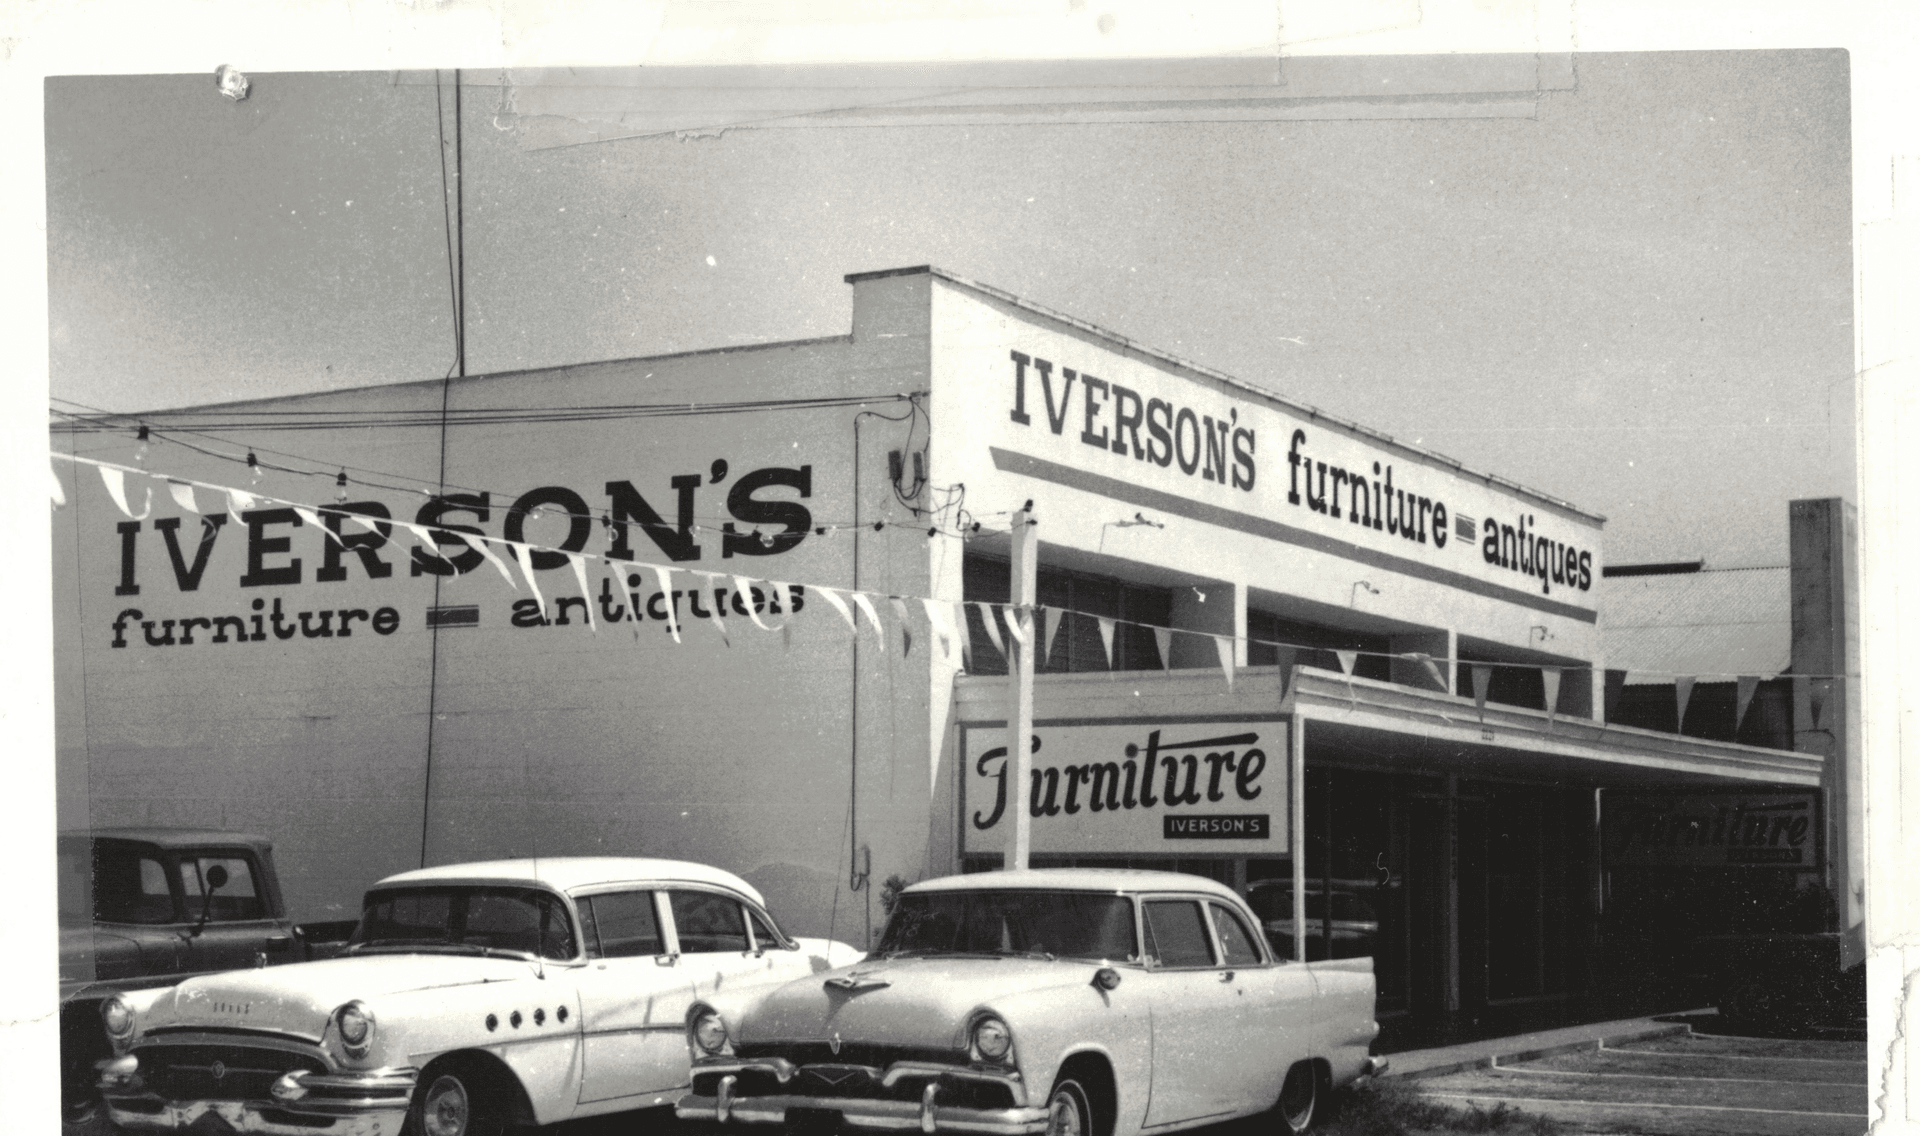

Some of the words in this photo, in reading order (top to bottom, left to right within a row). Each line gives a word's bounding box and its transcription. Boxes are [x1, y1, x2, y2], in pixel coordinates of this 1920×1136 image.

[1010, 348, 1256, 493] IVERSON'S
[1288, 428, 1448, 549] furniture
[1483, 515, 1593, 594] antiques
[114, 457, 812, 597] IVERSON'S
[111, 597, 401, 649] furniture
[511, 573, 805, 633] antiques
[973, 729, 1267, 831] Furniture
[1171, 818, 1260, 833] IVERSON'S
